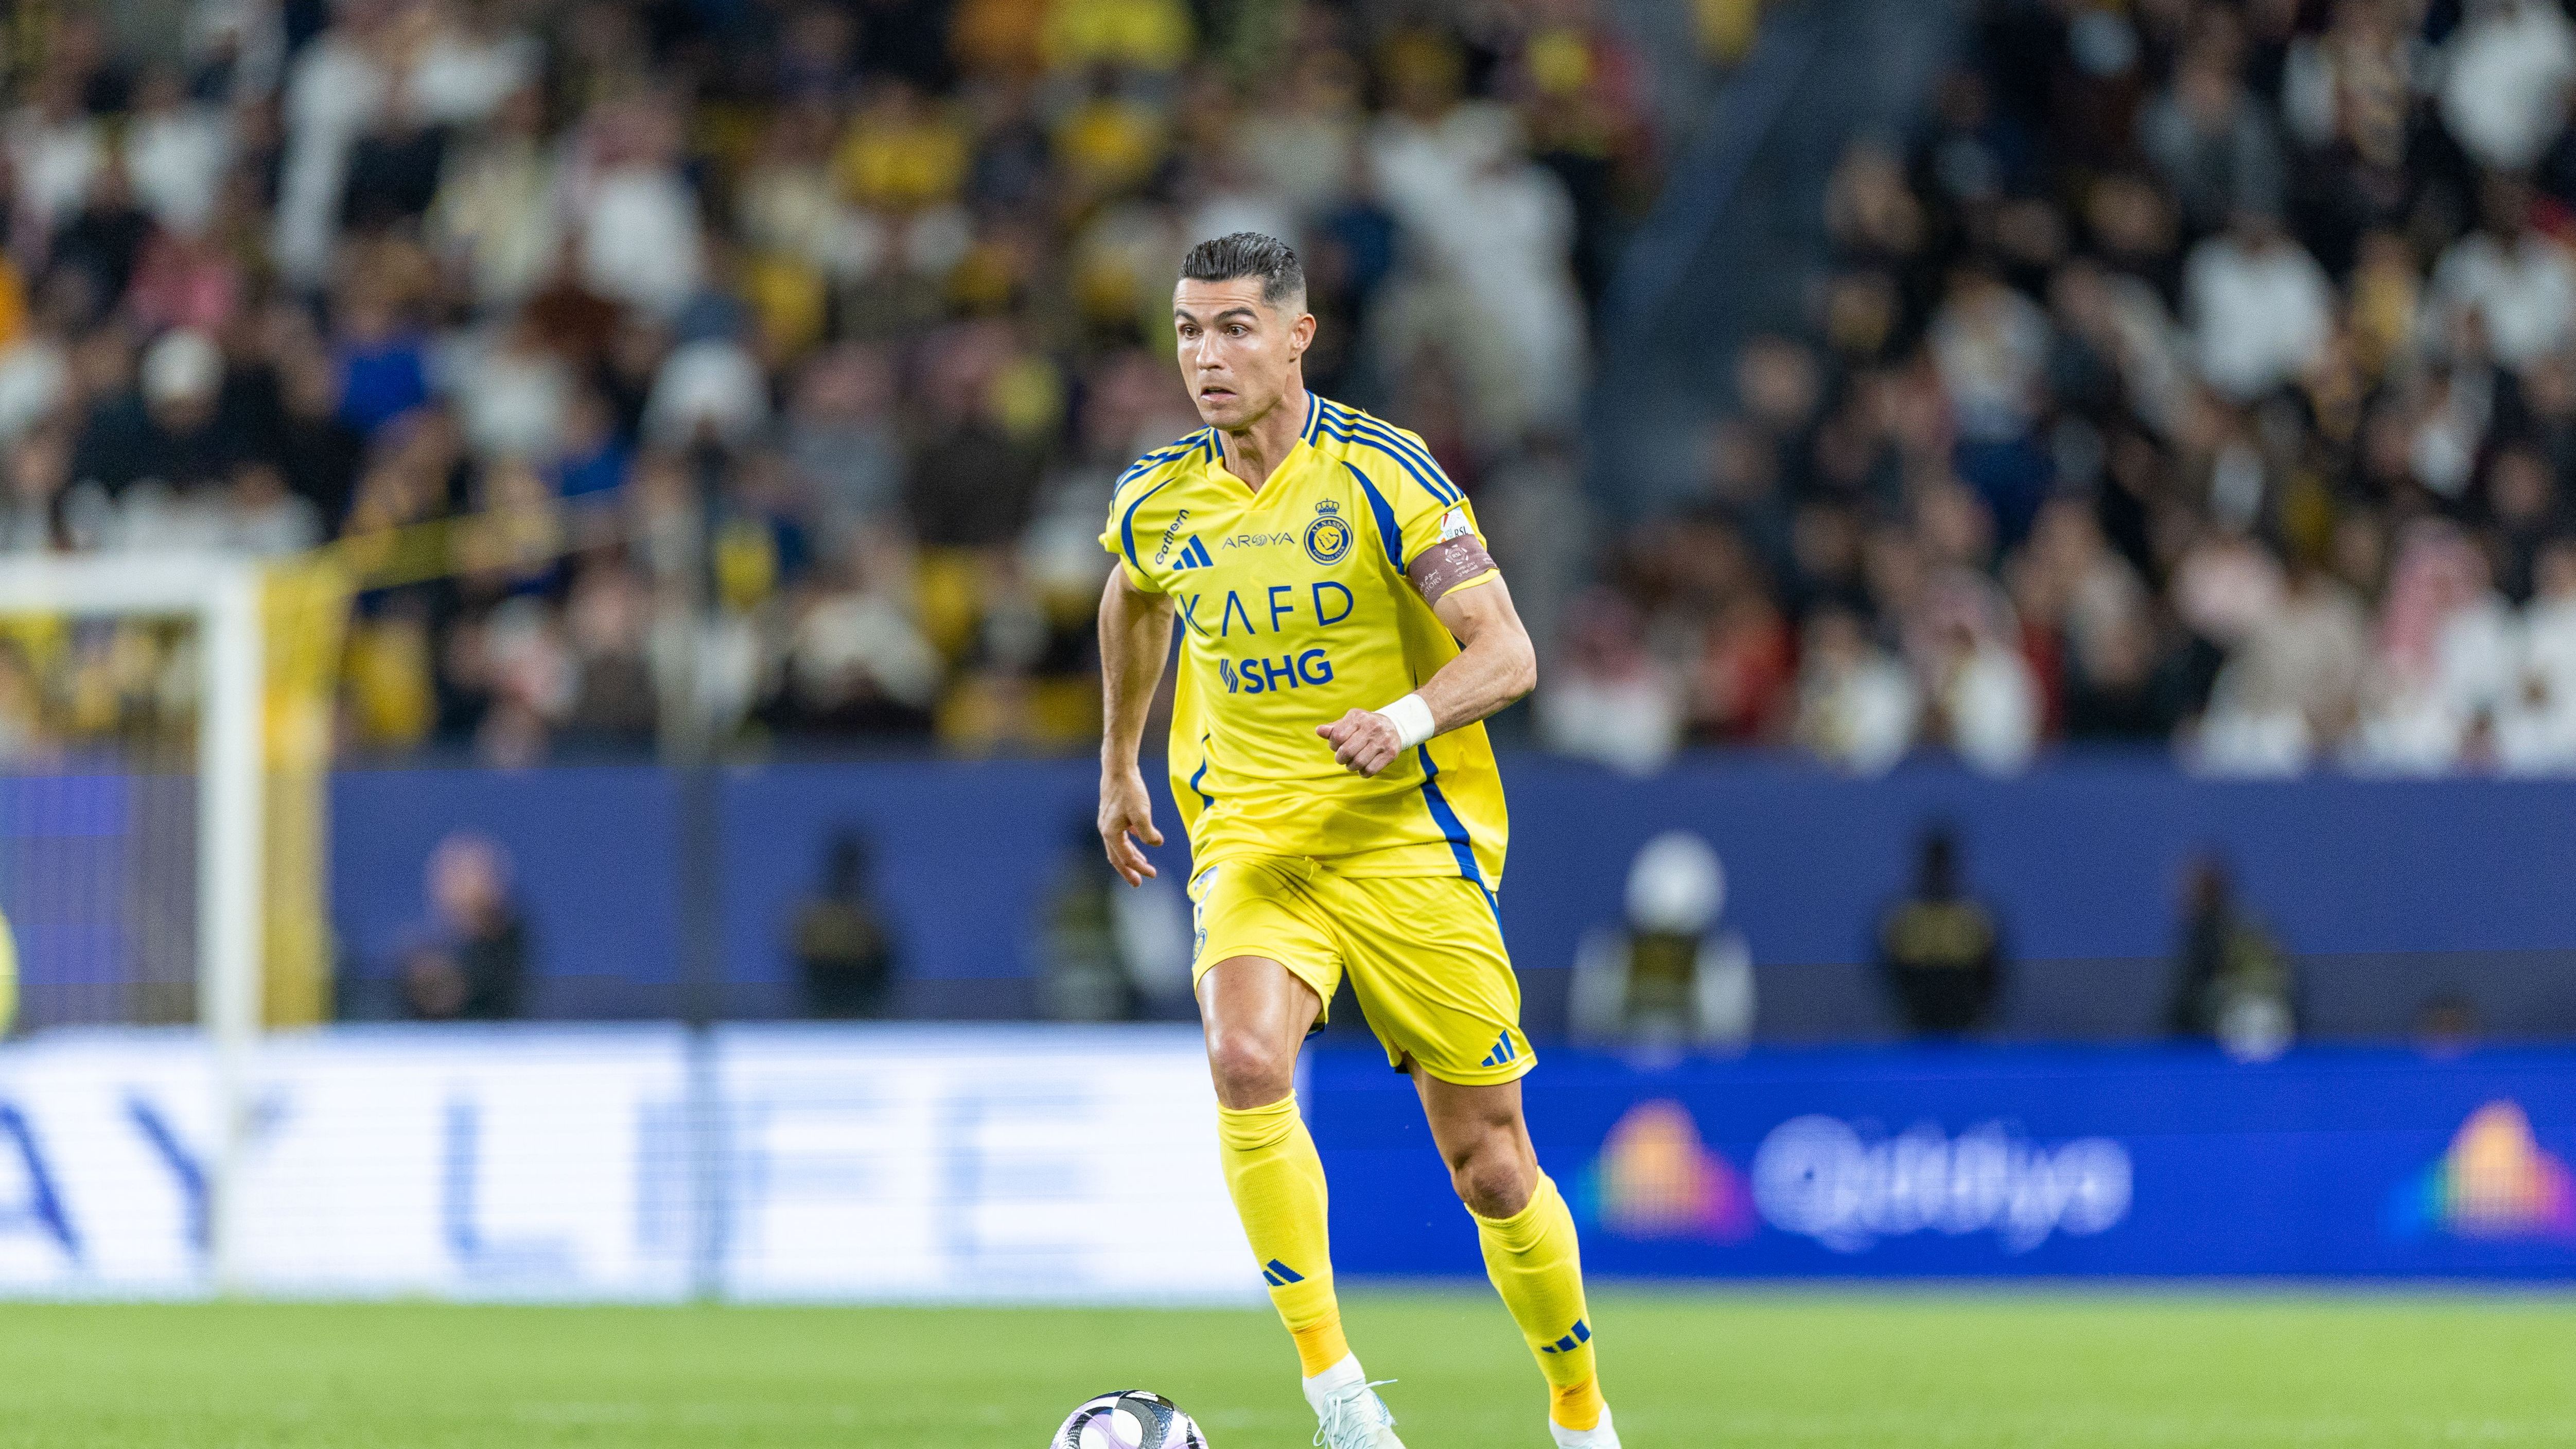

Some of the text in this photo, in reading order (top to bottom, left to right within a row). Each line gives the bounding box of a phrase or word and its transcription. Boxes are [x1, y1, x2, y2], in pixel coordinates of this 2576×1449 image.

[1155, 509, 1189, 565] Gathern
[1454, 526, 1468, 538] RSL
[1180, 581, 1354, 637] KAFD
[1239, 649, 1335, 694] SHG
